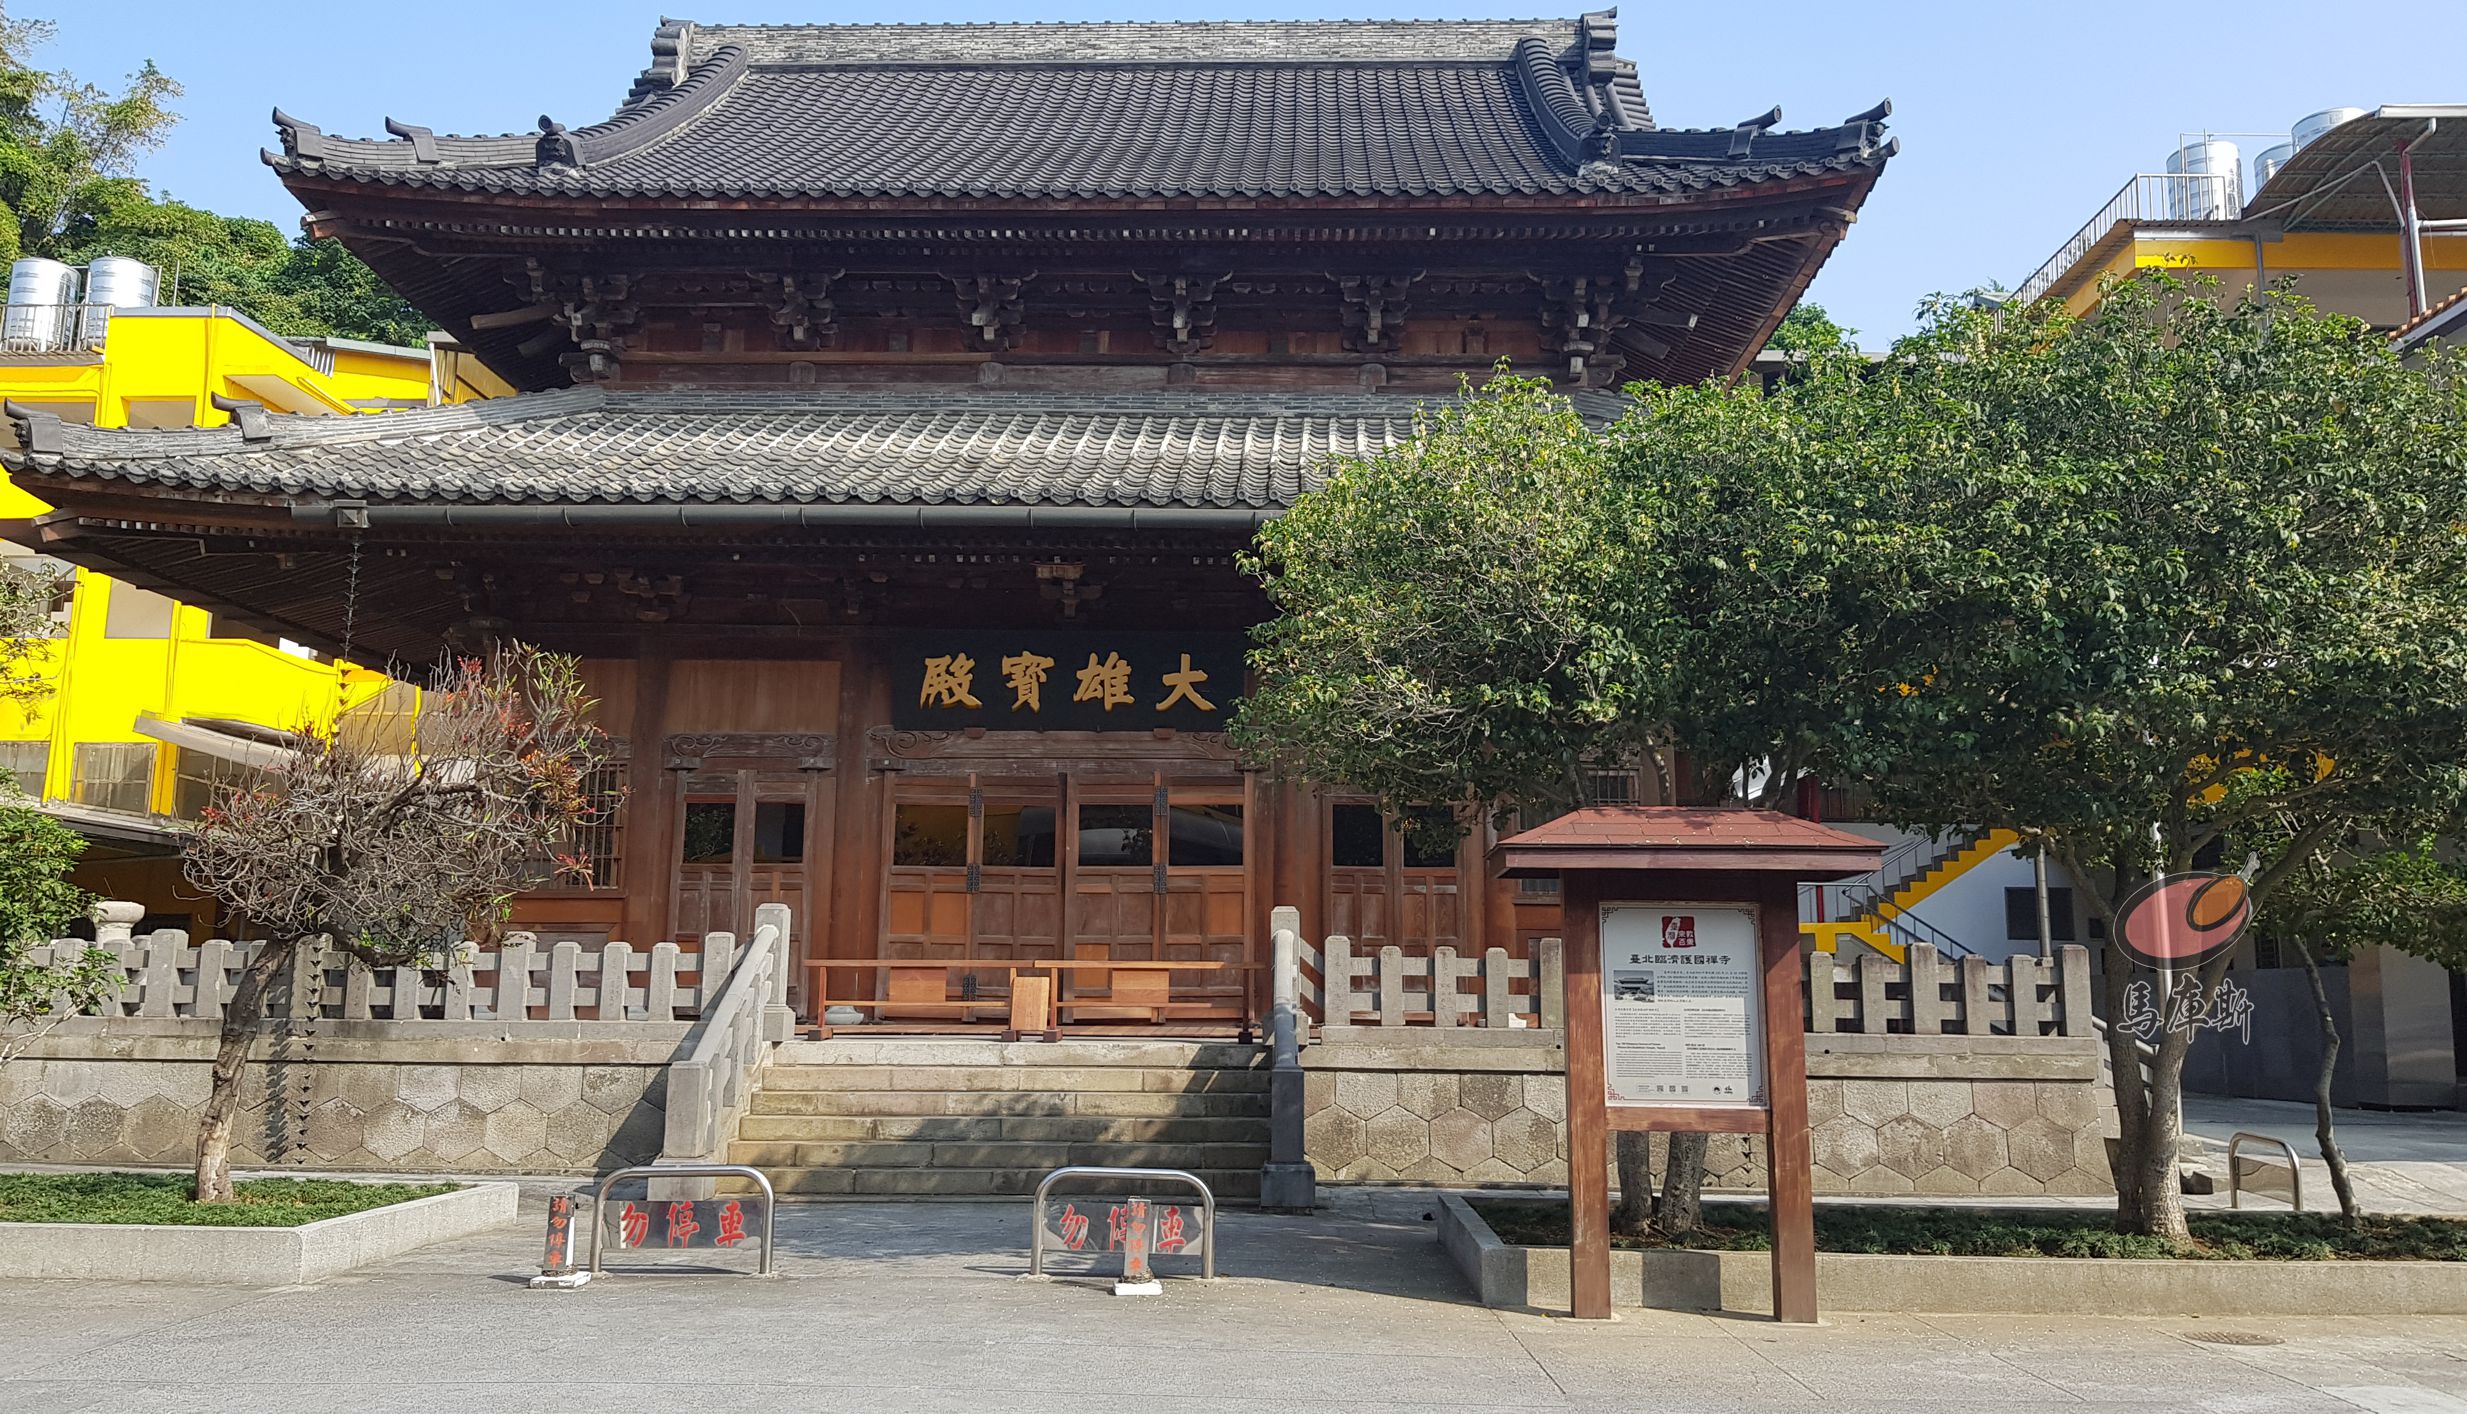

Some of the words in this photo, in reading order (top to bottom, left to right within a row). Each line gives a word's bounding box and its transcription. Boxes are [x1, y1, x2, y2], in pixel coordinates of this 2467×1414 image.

[920, 651, 1218, 713] 大雄寶殿
[621, 1200, 747, 1249] 勿停車
